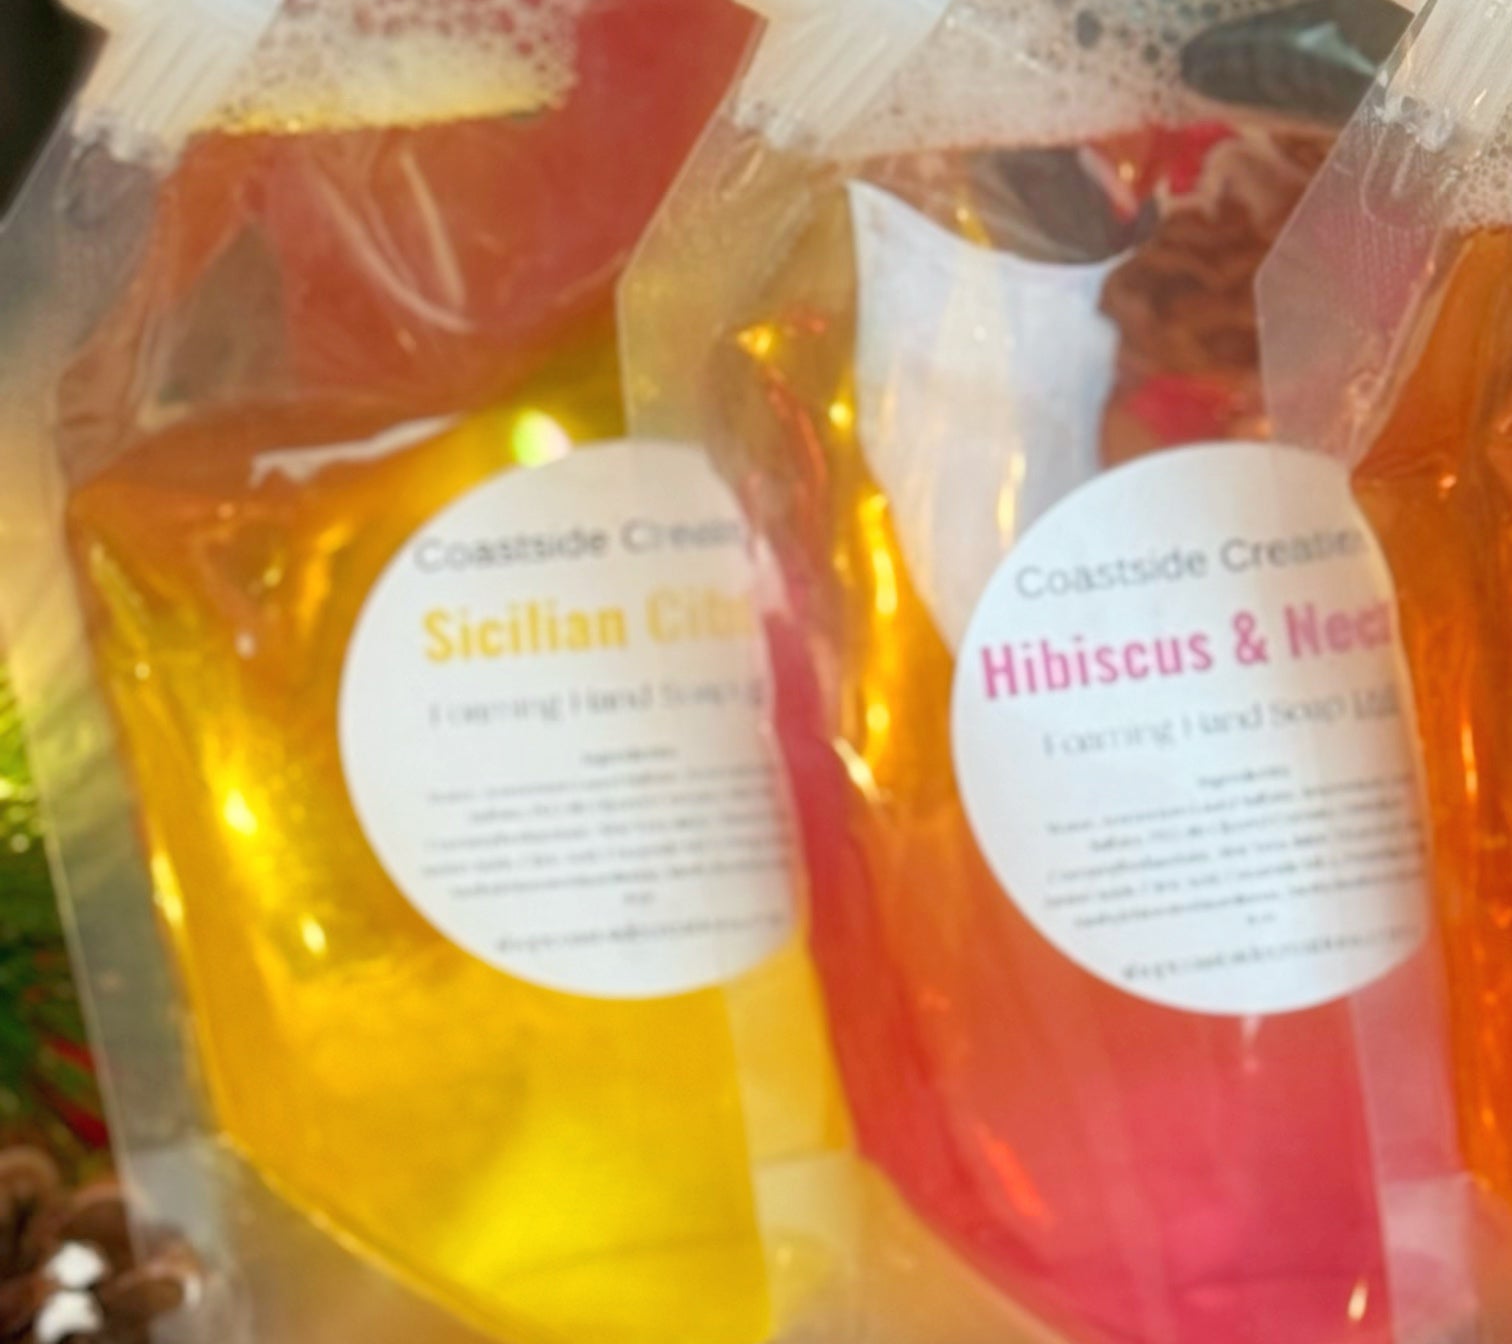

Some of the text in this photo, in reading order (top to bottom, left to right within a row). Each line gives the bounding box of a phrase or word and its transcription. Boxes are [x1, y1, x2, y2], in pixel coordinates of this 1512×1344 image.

[413, 527, 608, 575] Coastside
[1014, 548, 1209, 600] Coastside
[421, 596, 628, 665] Sicilian
[979, 630, 1215, 702] Hibiscus
[1230, 609, 1269, 668] &
